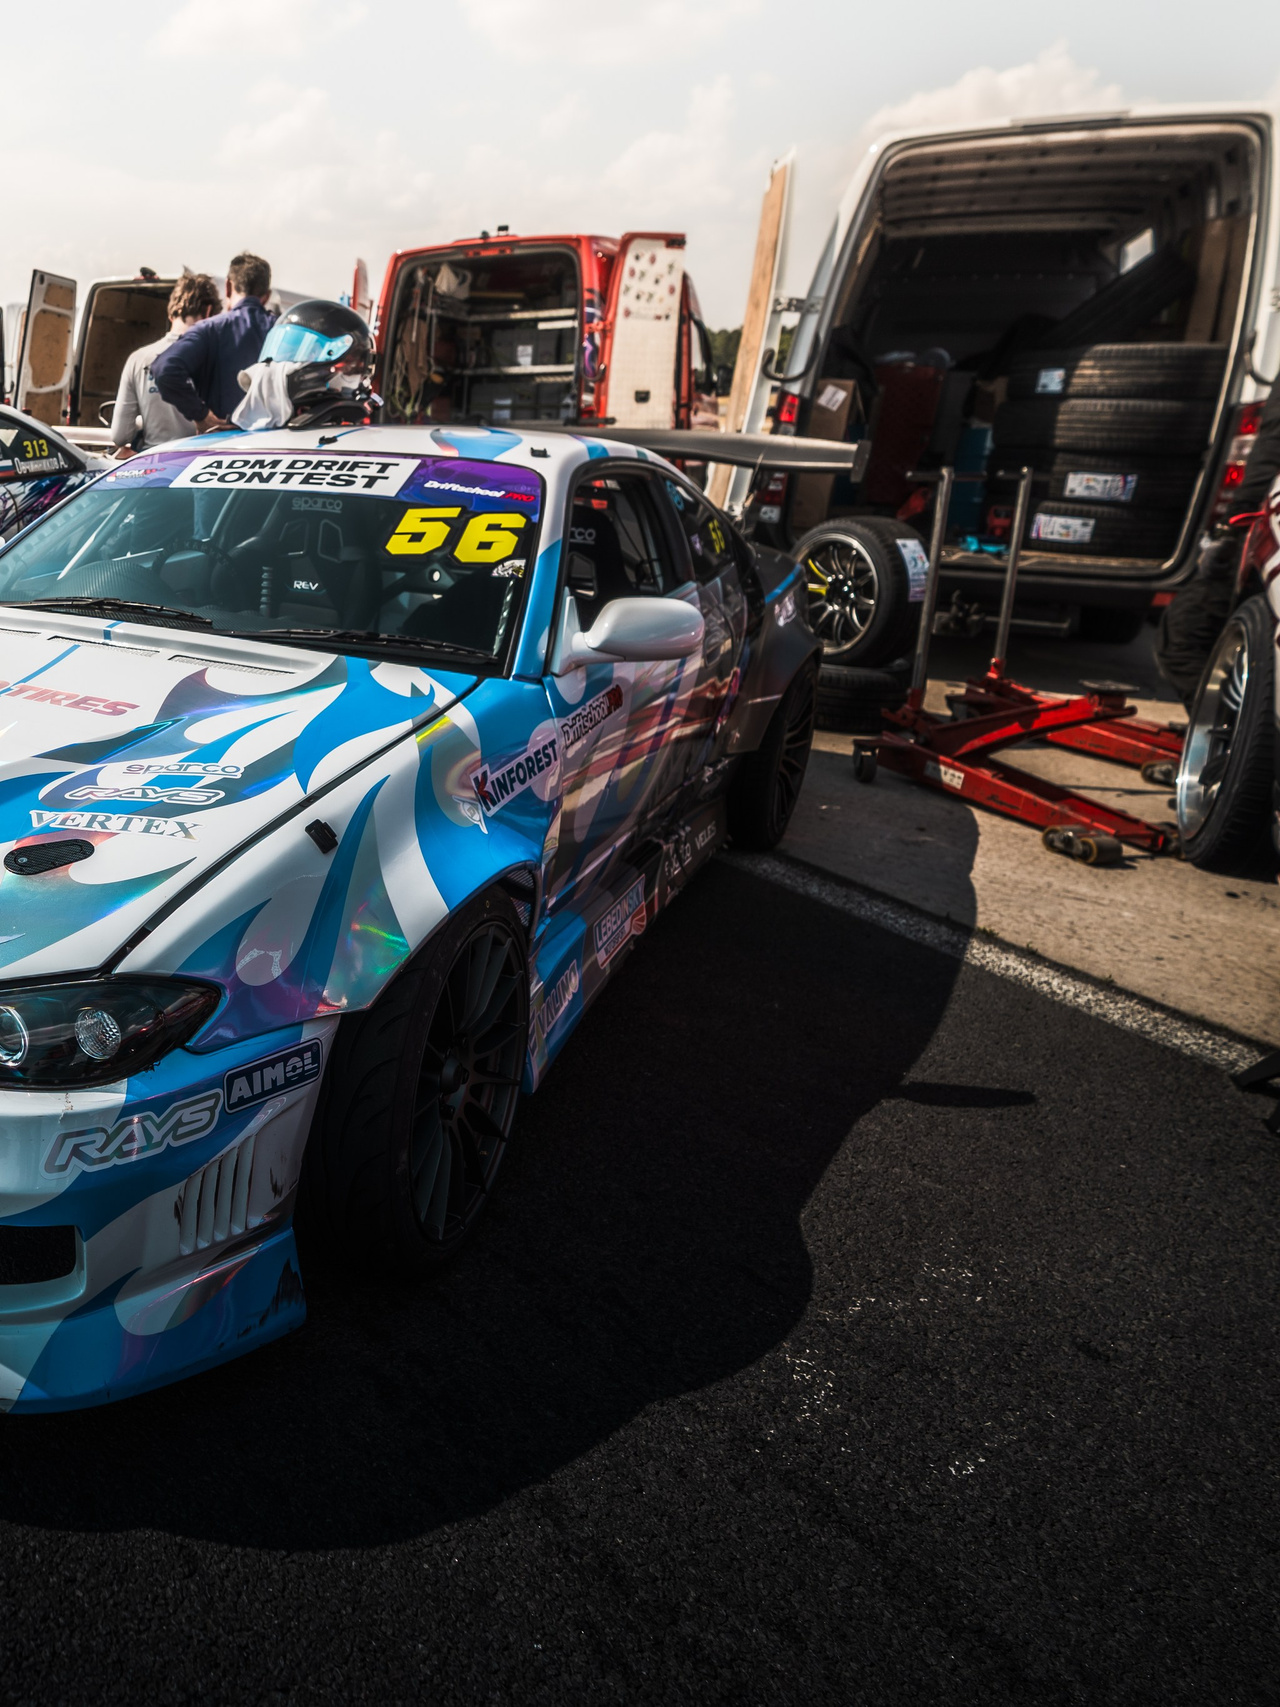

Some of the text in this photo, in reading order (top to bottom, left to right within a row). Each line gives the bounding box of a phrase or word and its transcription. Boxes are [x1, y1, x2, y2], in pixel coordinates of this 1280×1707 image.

[23, 439, 49, 459] 313
[201, 459, 400, 474] ADM DRIFT
[189, 471, 391, 489] CONTEST
[291, 496, 343, 513] sparco
[385, 507, 527, 563] 56
[293, 580, 319, 591] REV
[5, 683, 141, 717] TIRES
[123, 763, 241, 777] sparco
[472, 738, 558, 812] KINFOREST
[66, 786, 223, 804] RAYS
[33, 811, 204, 841] VERTEX
[229, 1051, 319, 1104] AIMOL
[44, 1091, 221, 1173] RAYS
